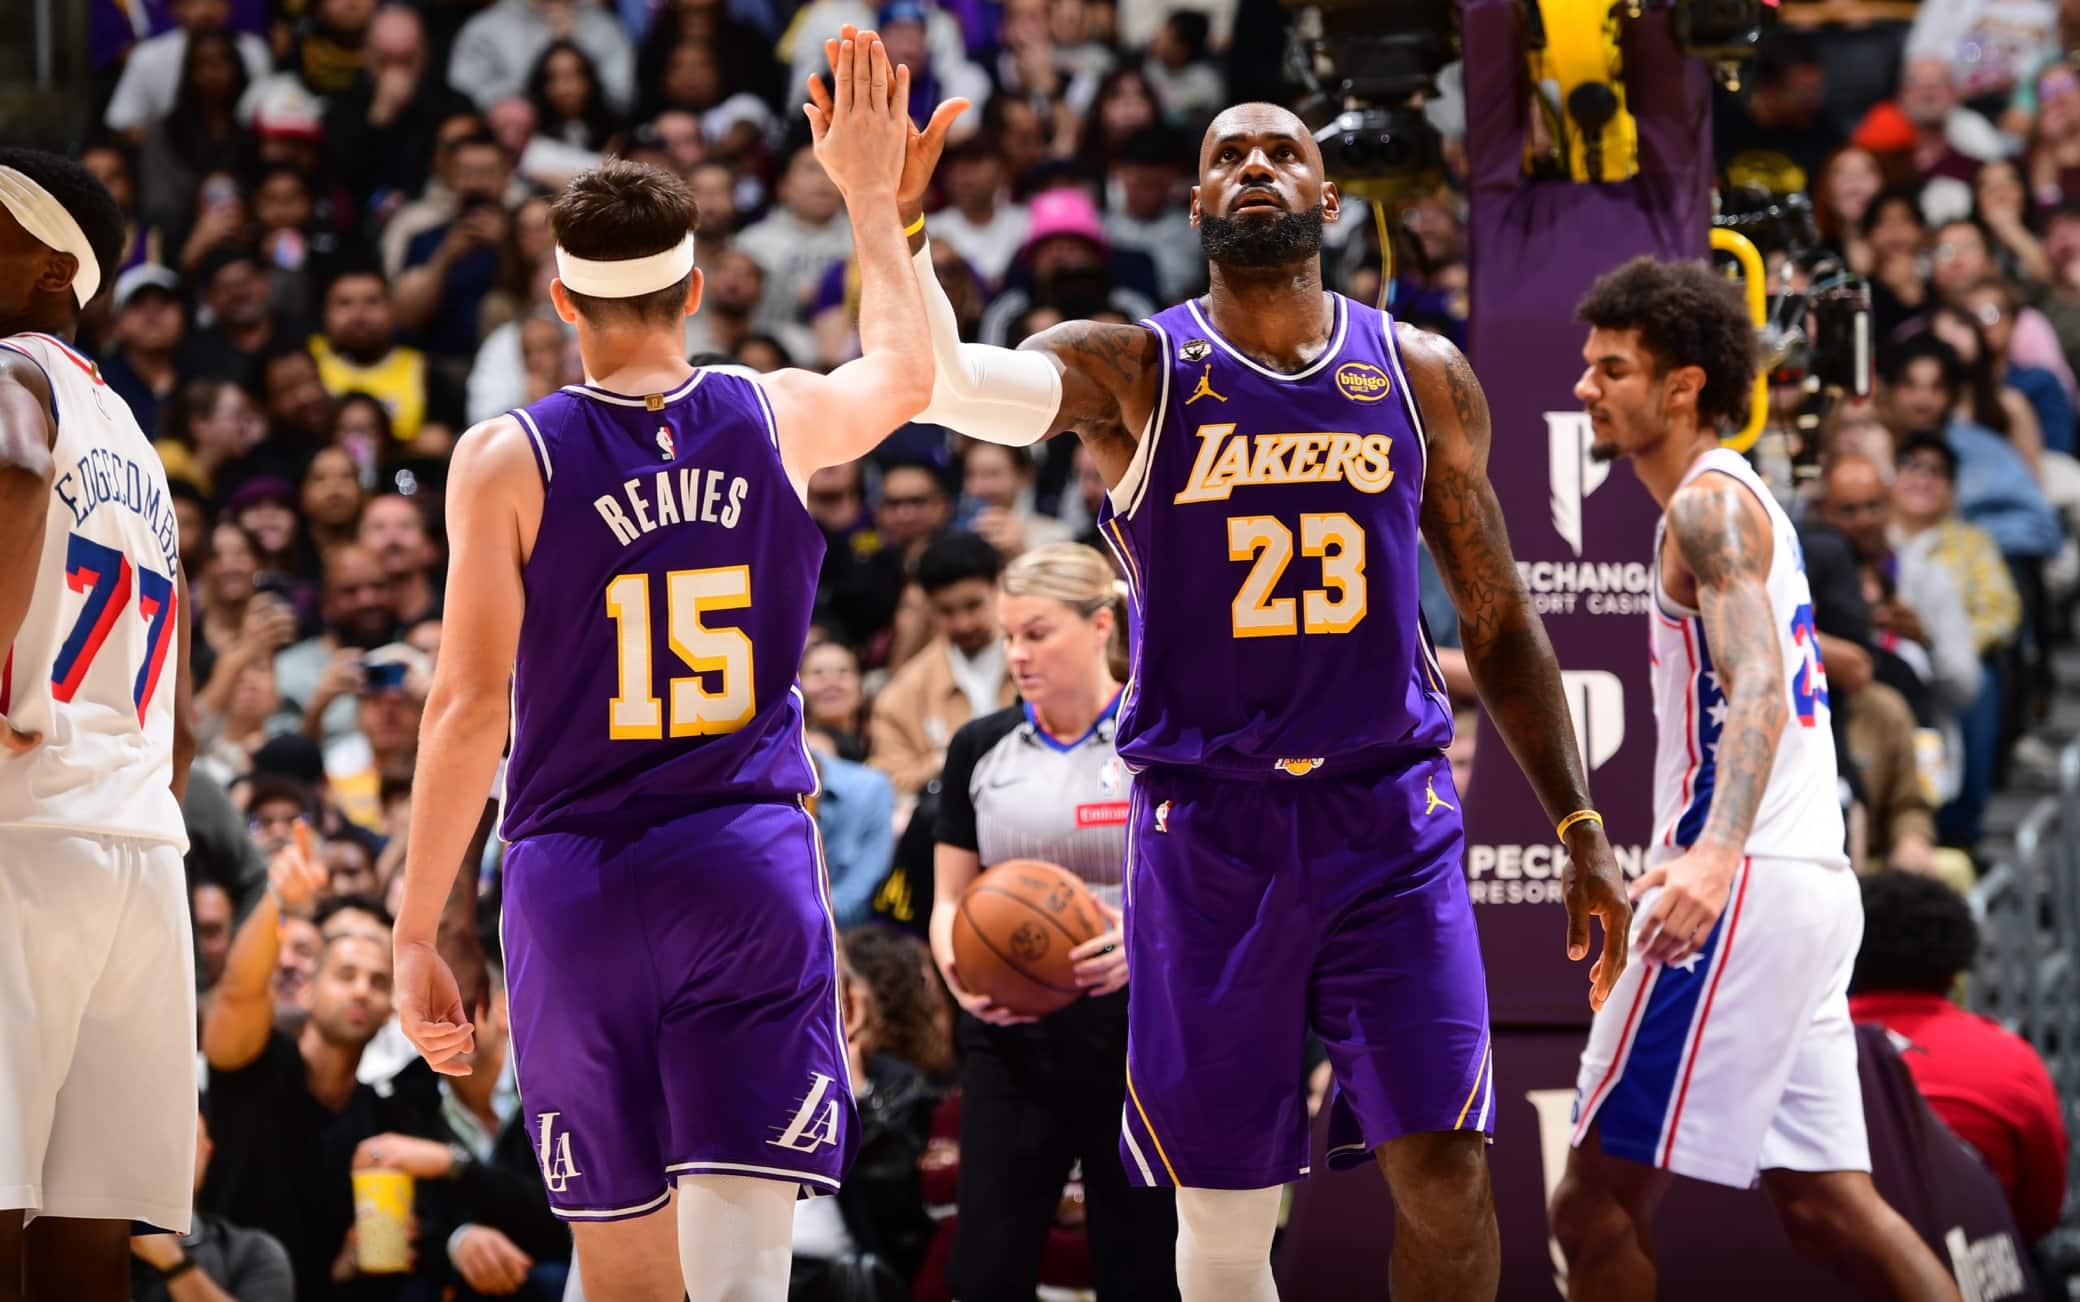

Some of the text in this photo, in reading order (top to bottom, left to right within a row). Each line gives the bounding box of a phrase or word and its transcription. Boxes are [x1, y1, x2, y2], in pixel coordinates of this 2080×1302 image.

[1340, 372, 1386, 390] bibigo
[1173, 423, 1394, 505] LAKERS
[593, 468, 748, 546] REAVES
[1227, 512, 1367, 638] 23
[1585, 593, 1650, 615] CASIN
[51, 531, 178, 731] 77
[606, 564, 756, 739] 15
[1469, 880, 1563, 905] RESOR
[536, 1112, 581, 1192] LA
[766, 1072, 839, 1153] LA
